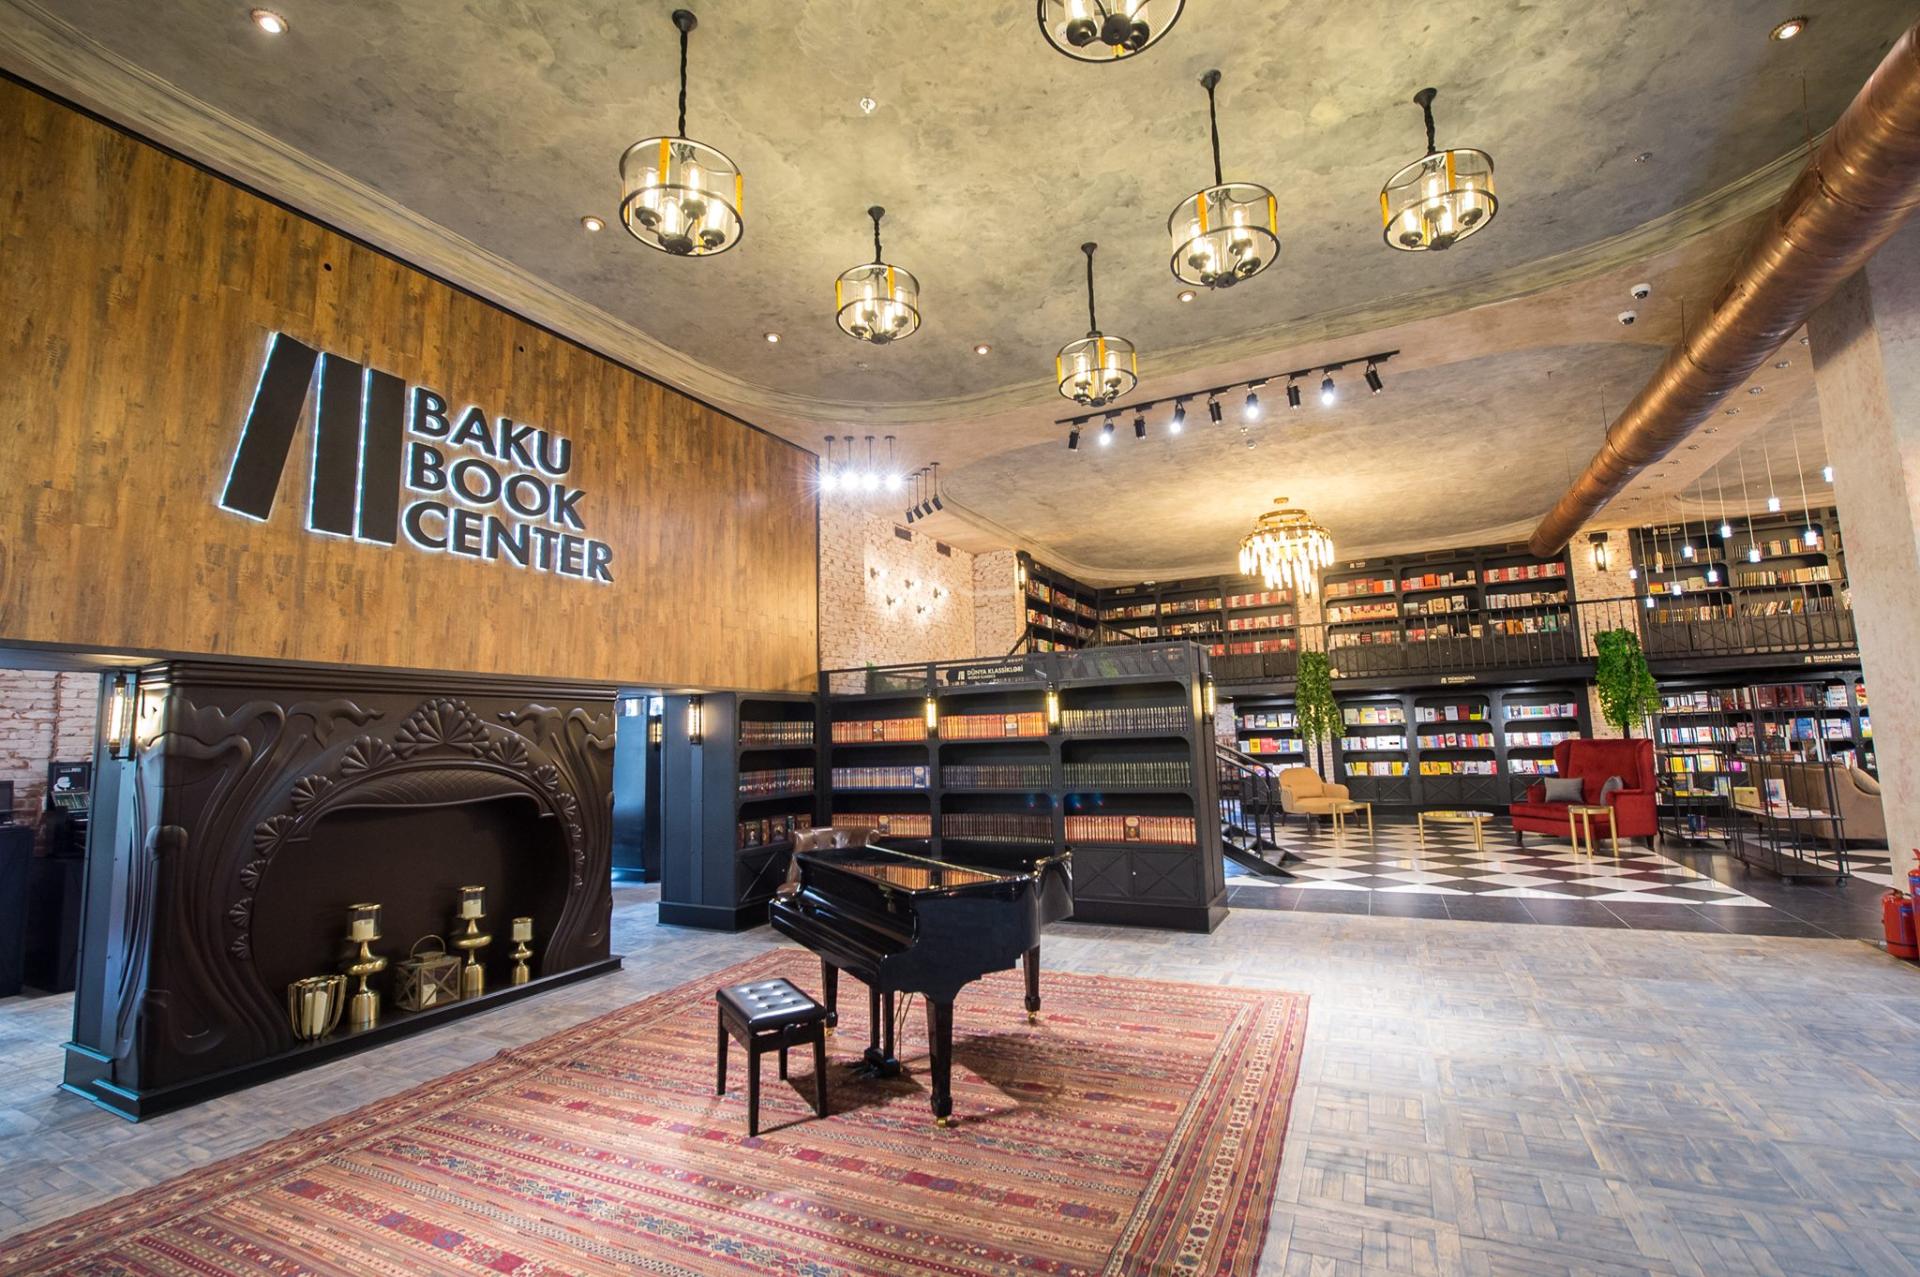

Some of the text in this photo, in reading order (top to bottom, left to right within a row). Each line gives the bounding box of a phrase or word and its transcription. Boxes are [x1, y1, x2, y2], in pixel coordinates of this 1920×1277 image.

[409, 385, 572, 475] BAKU
[405, 441, 587, 530] BOOK
[401, 499, 614, 583] CENTER
